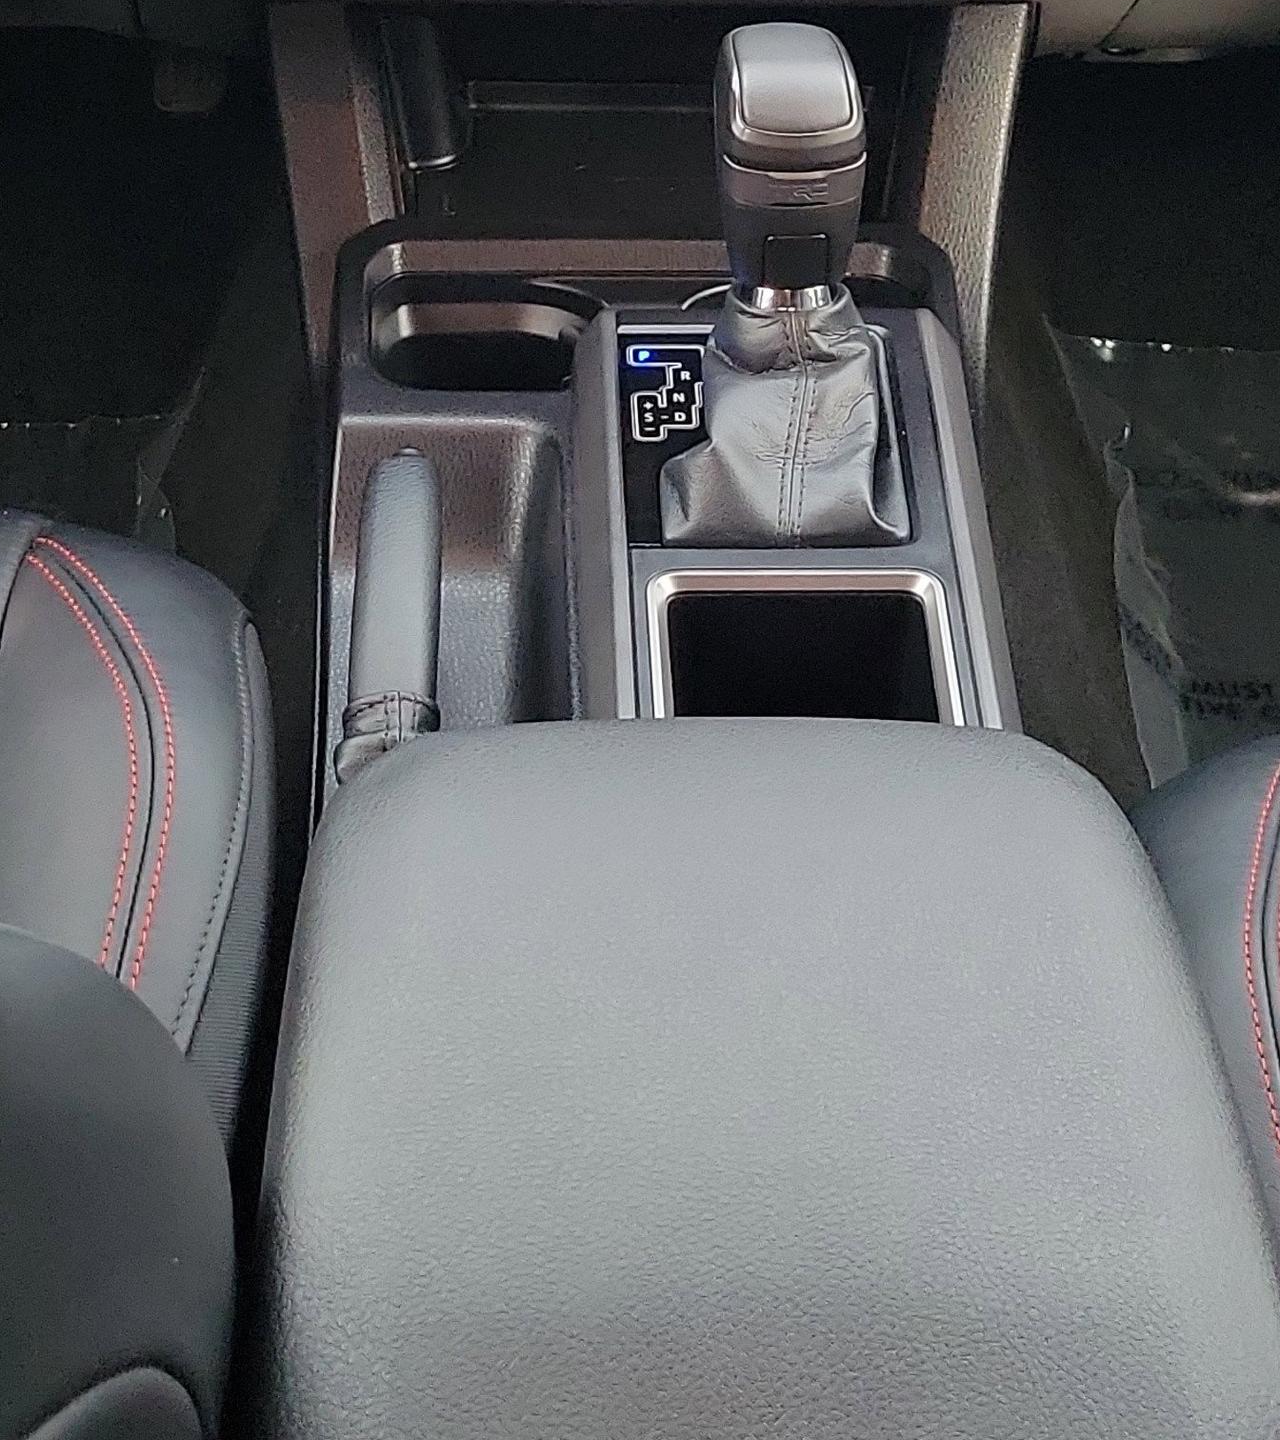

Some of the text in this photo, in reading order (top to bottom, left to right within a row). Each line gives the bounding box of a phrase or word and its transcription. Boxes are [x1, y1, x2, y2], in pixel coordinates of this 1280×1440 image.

[638, 349, 650, 361] P
[681, 370, 691, 381] R
[672, 392, 685, 403] N
[644, 411, 654, 422] S
[674, 411, 686, 422] D
